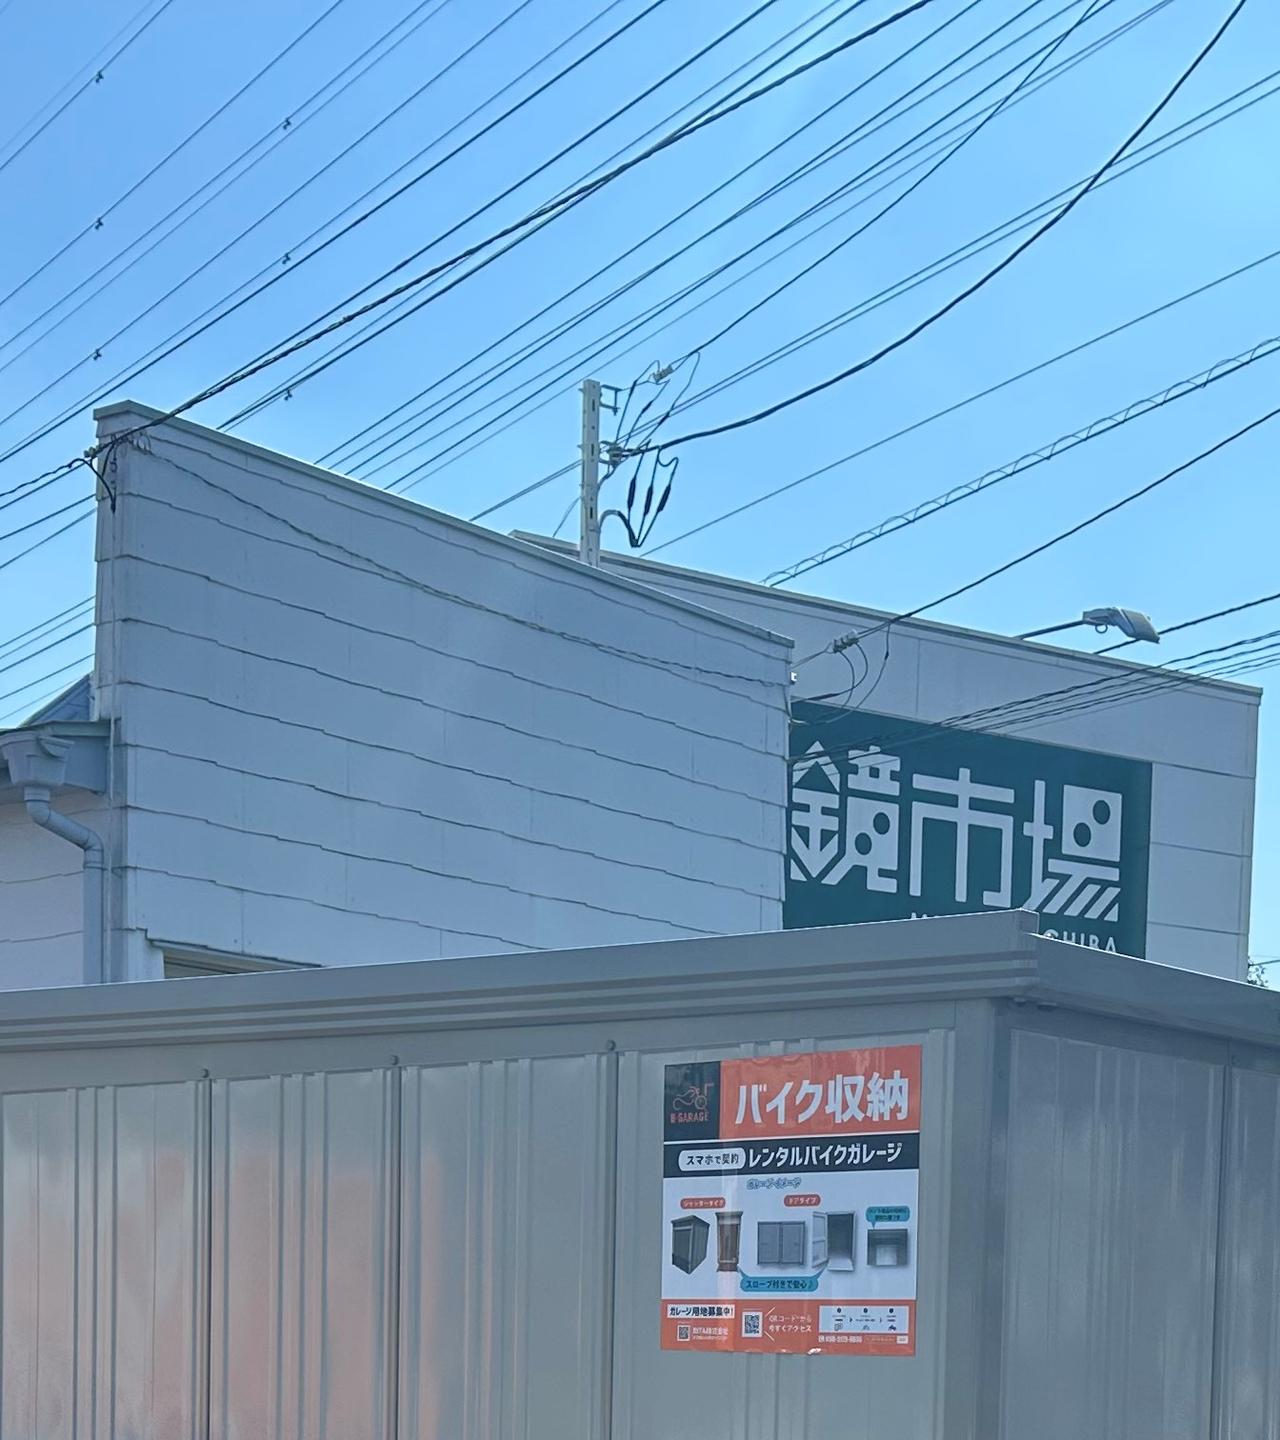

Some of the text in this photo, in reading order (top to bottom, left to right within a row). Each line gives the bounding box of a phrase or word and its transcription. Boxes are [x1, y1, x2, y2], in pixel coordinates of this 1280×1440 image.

[790, 740, 1122, 922] 鏡市場
[734, 1070, 908, 1125] バイク収納
[749, 1142, 903, 1168] レンタルバイクガレージ
